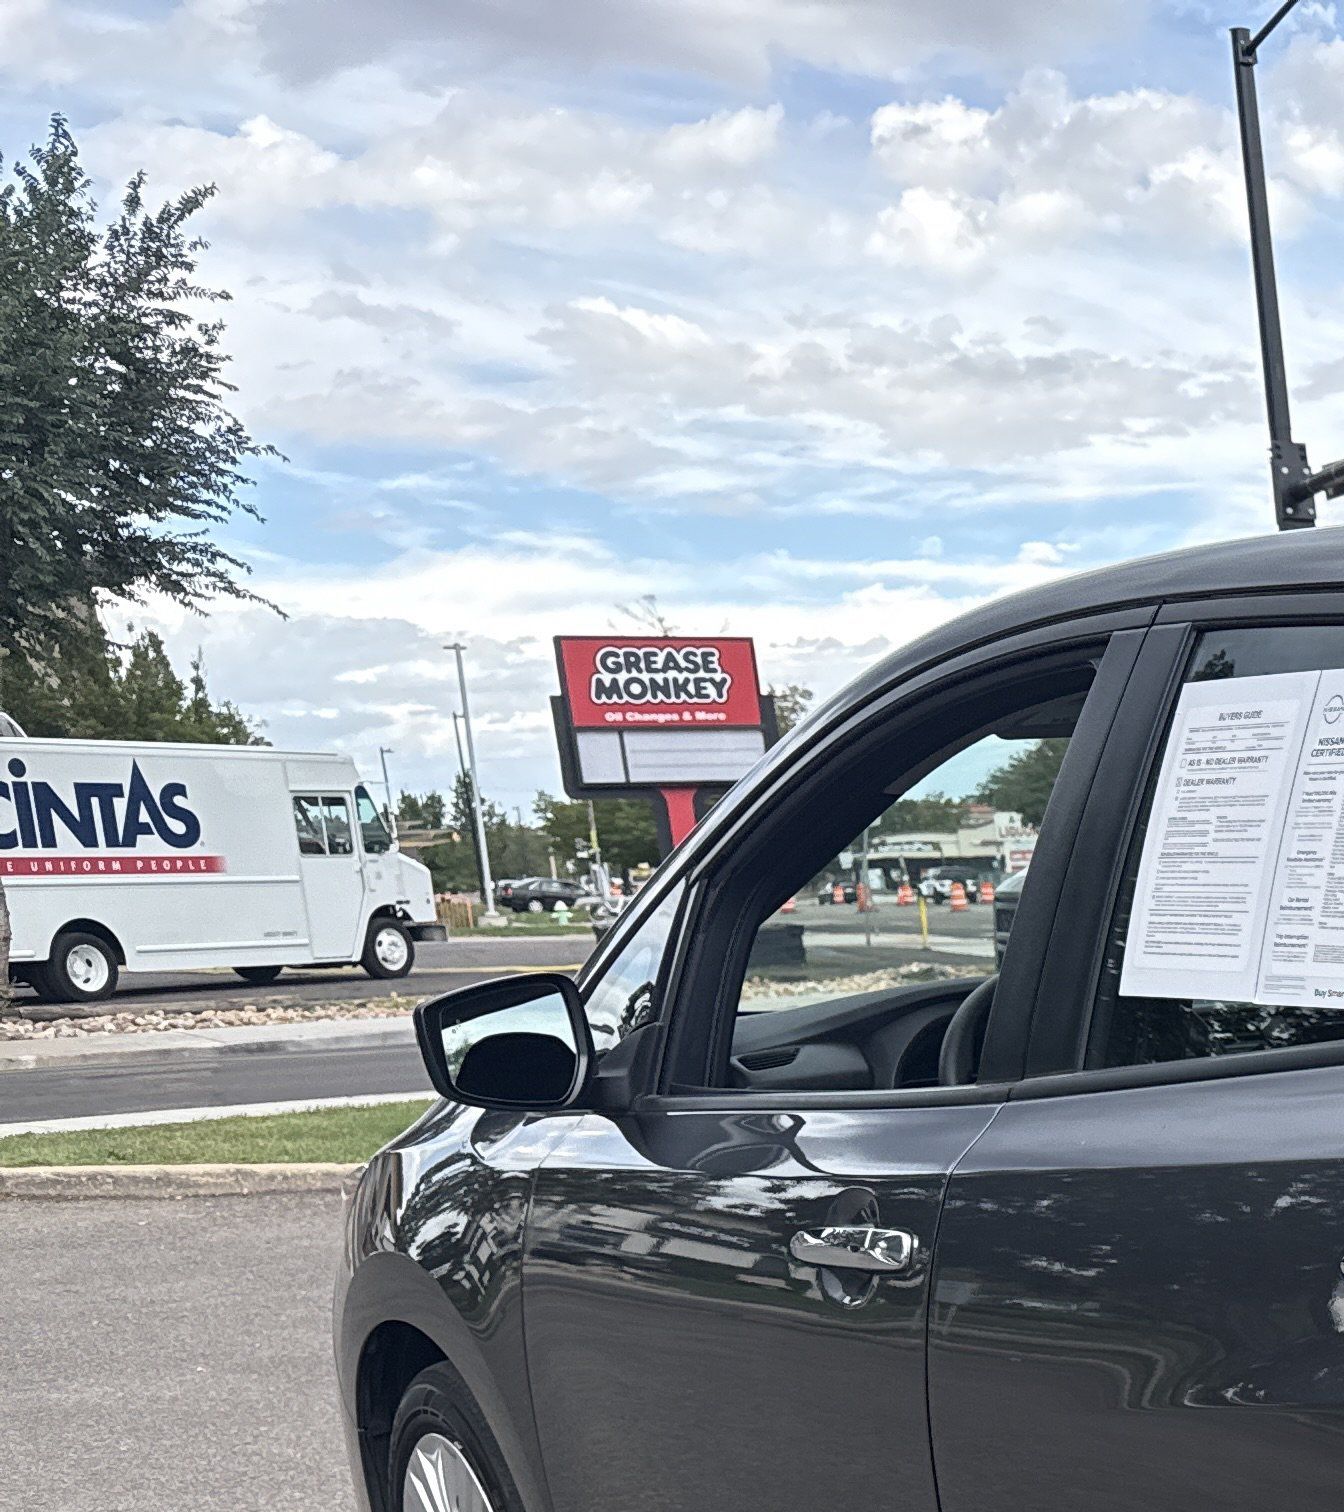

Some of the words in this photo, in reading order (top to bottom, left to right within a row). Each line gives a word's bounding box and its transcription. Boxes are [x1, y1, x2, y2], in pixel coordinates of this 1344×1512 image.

[600, 650, 718, 674] GREASE
[594, 676, 728, 701] MONKEY
[604, 711, 624, 721] Oil
[626, 712, 680, 723] Changes
[682, 711, 693, 721] &
[695, 711, 727, 721] More
[30, 860, 122, 872] UNIFORM
[136, 860, 207, 871] PEOPLE
[1314, 988, 1327, 999] Buy
